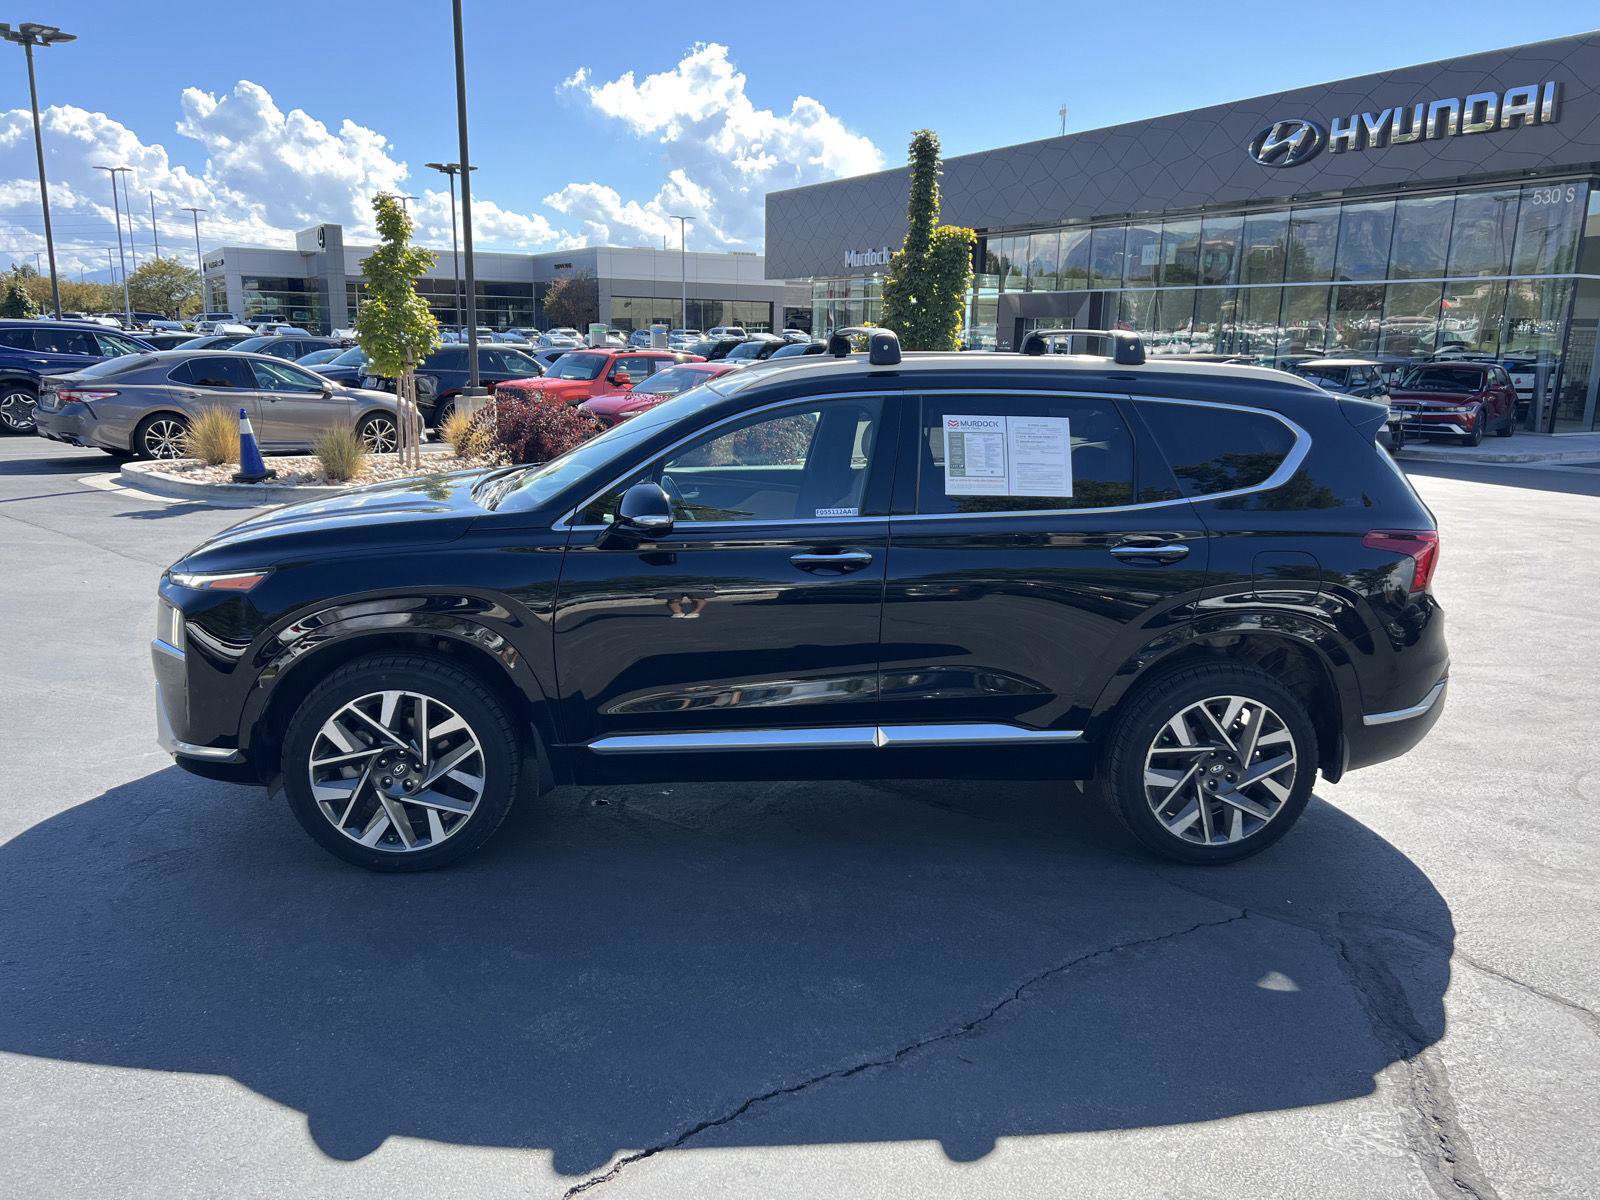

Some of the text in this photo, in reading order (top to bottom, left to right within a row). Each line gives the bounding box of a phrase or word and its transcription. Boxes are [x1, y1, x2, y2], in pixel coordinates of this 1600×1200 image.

[1329, 81, 1557, 153] HYUNDAI
[1532, 187, 1576, 205] 530 S
[844, 246, 890, 268] Murdock
